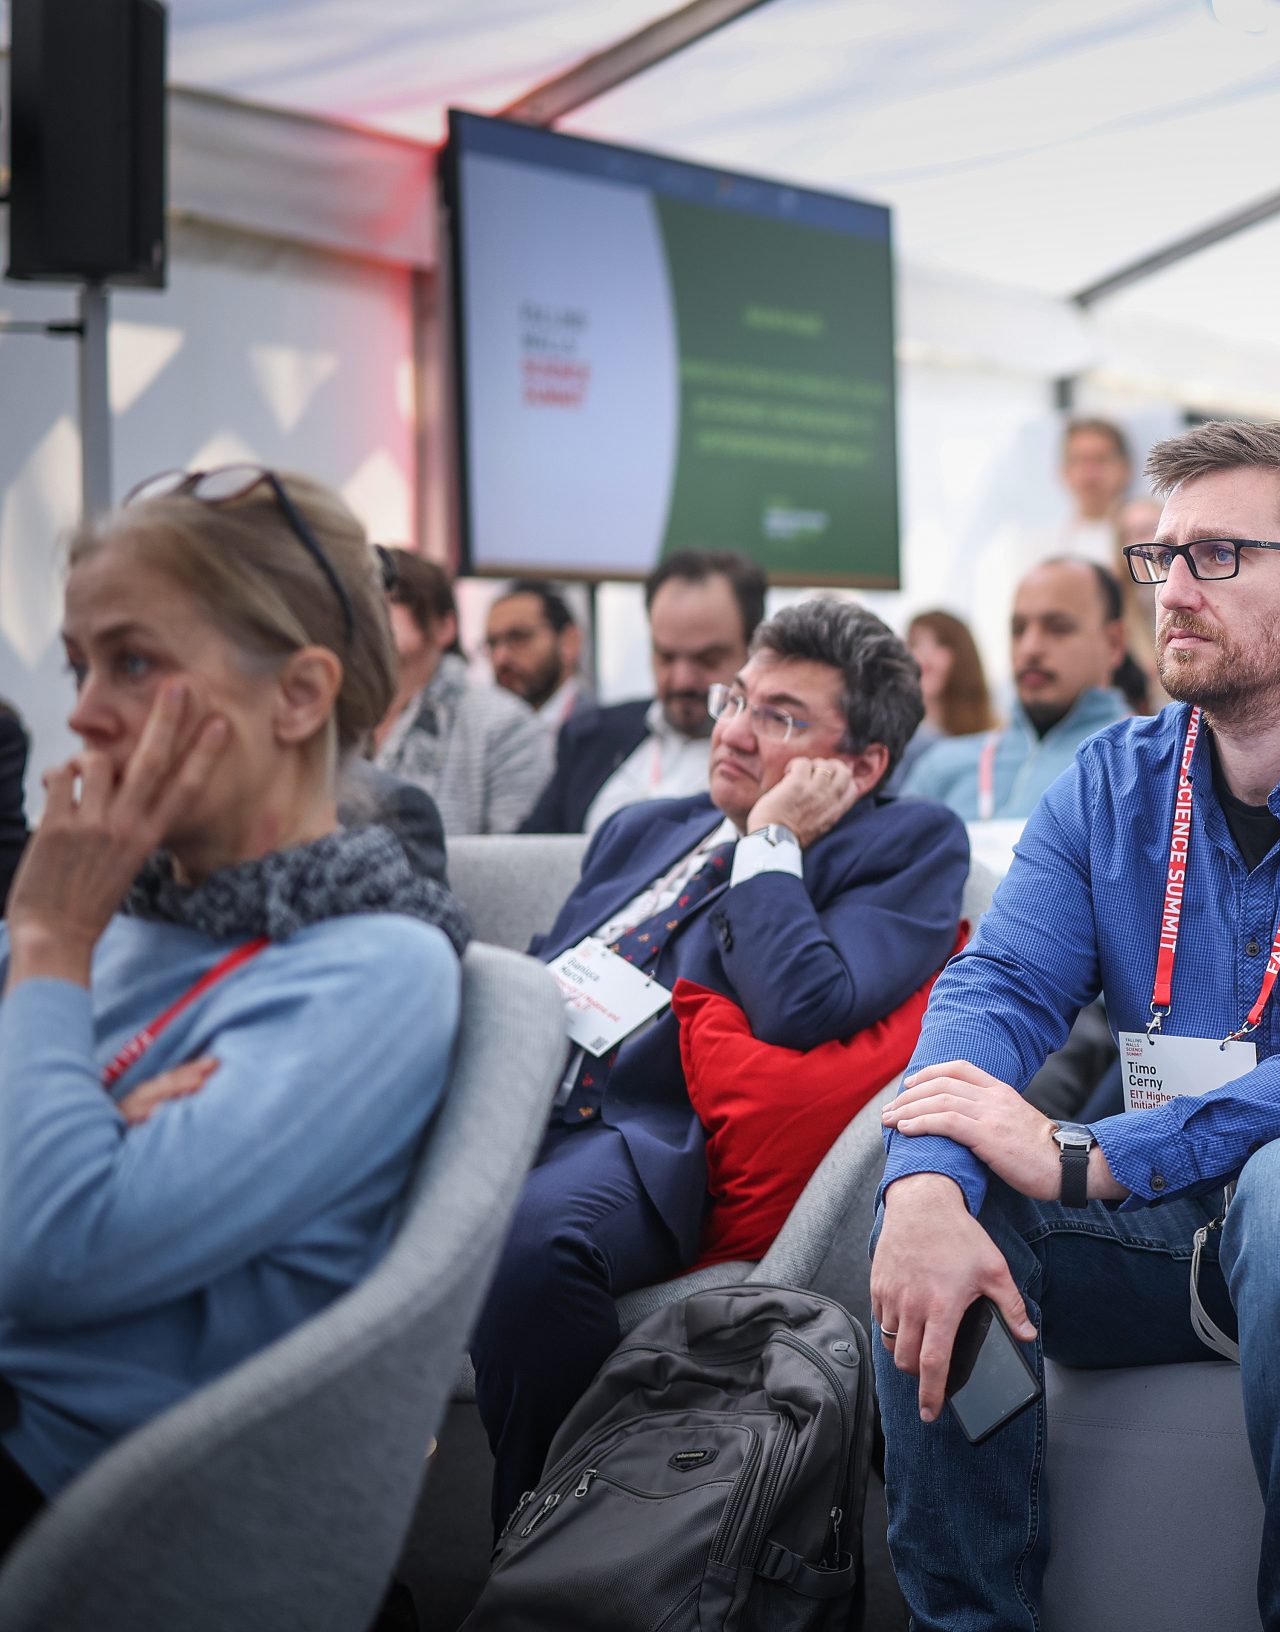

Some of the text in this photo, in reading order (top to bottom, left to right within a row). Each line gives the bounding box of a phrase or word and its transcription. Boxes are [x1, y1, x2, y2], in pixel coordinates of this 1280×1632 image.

[1170, 775, 1193, 864] SCIENCE
[1160, 868, 1186, 953] SUMMIT
[1127, 1061, 1157, 1075] Timo
[1129, 1074, 1163, 1091] Cerny
[1130, 1089, 1144, 1099] EIT
[1146, 1091, 1176, 1104] Higher
